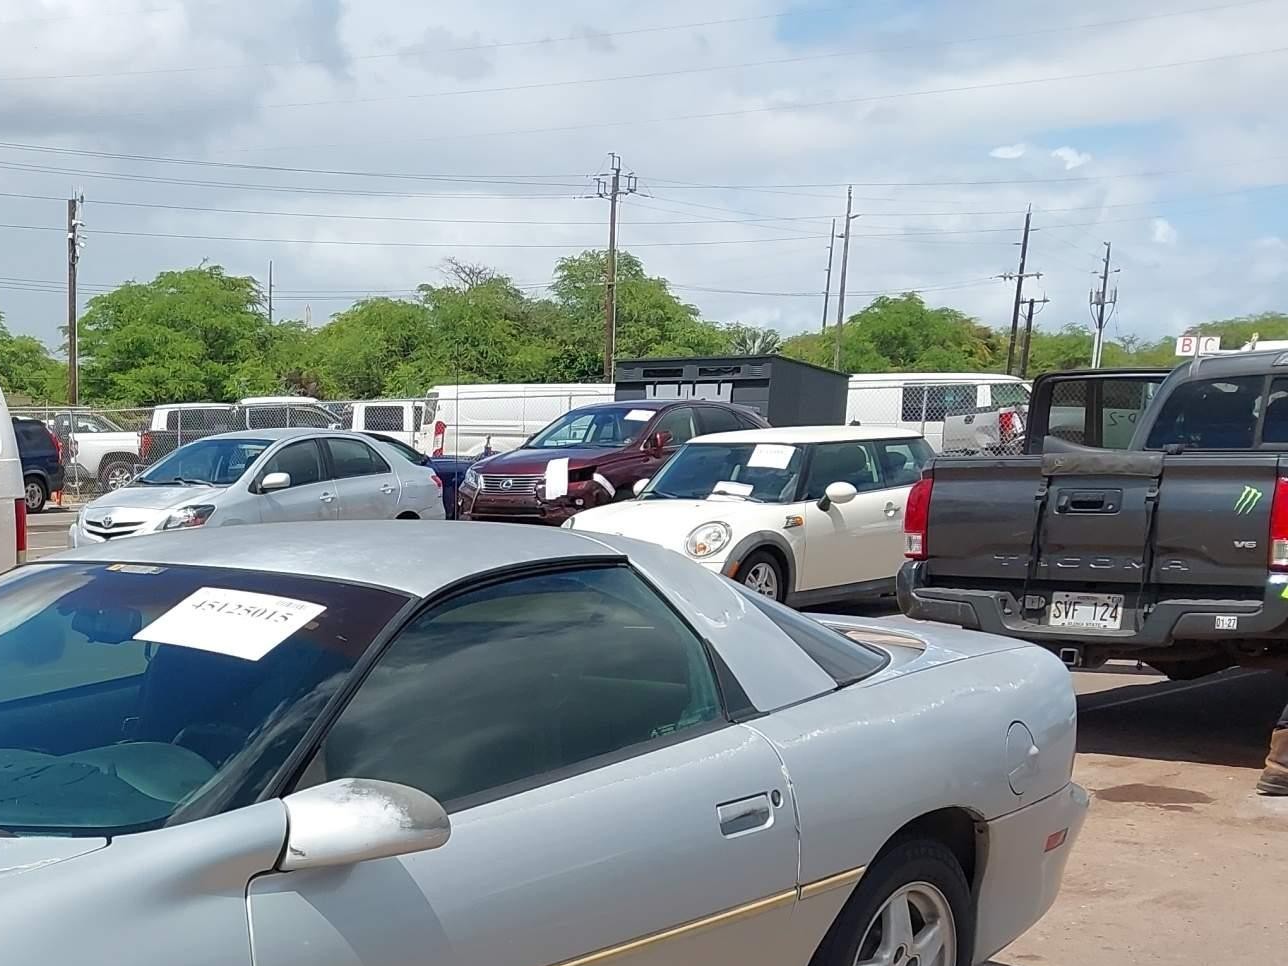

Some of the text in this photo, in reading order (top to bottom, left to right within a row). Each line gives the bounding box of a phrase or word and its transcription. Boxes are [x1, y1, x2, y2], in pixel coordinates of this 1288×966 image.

[1181, 338, 1192, 353] B
[1233, 540, 1257, 548] V6
[192, 600, 294, 623] 45125015
[1053, 600, 1118, 622] SVF 124
